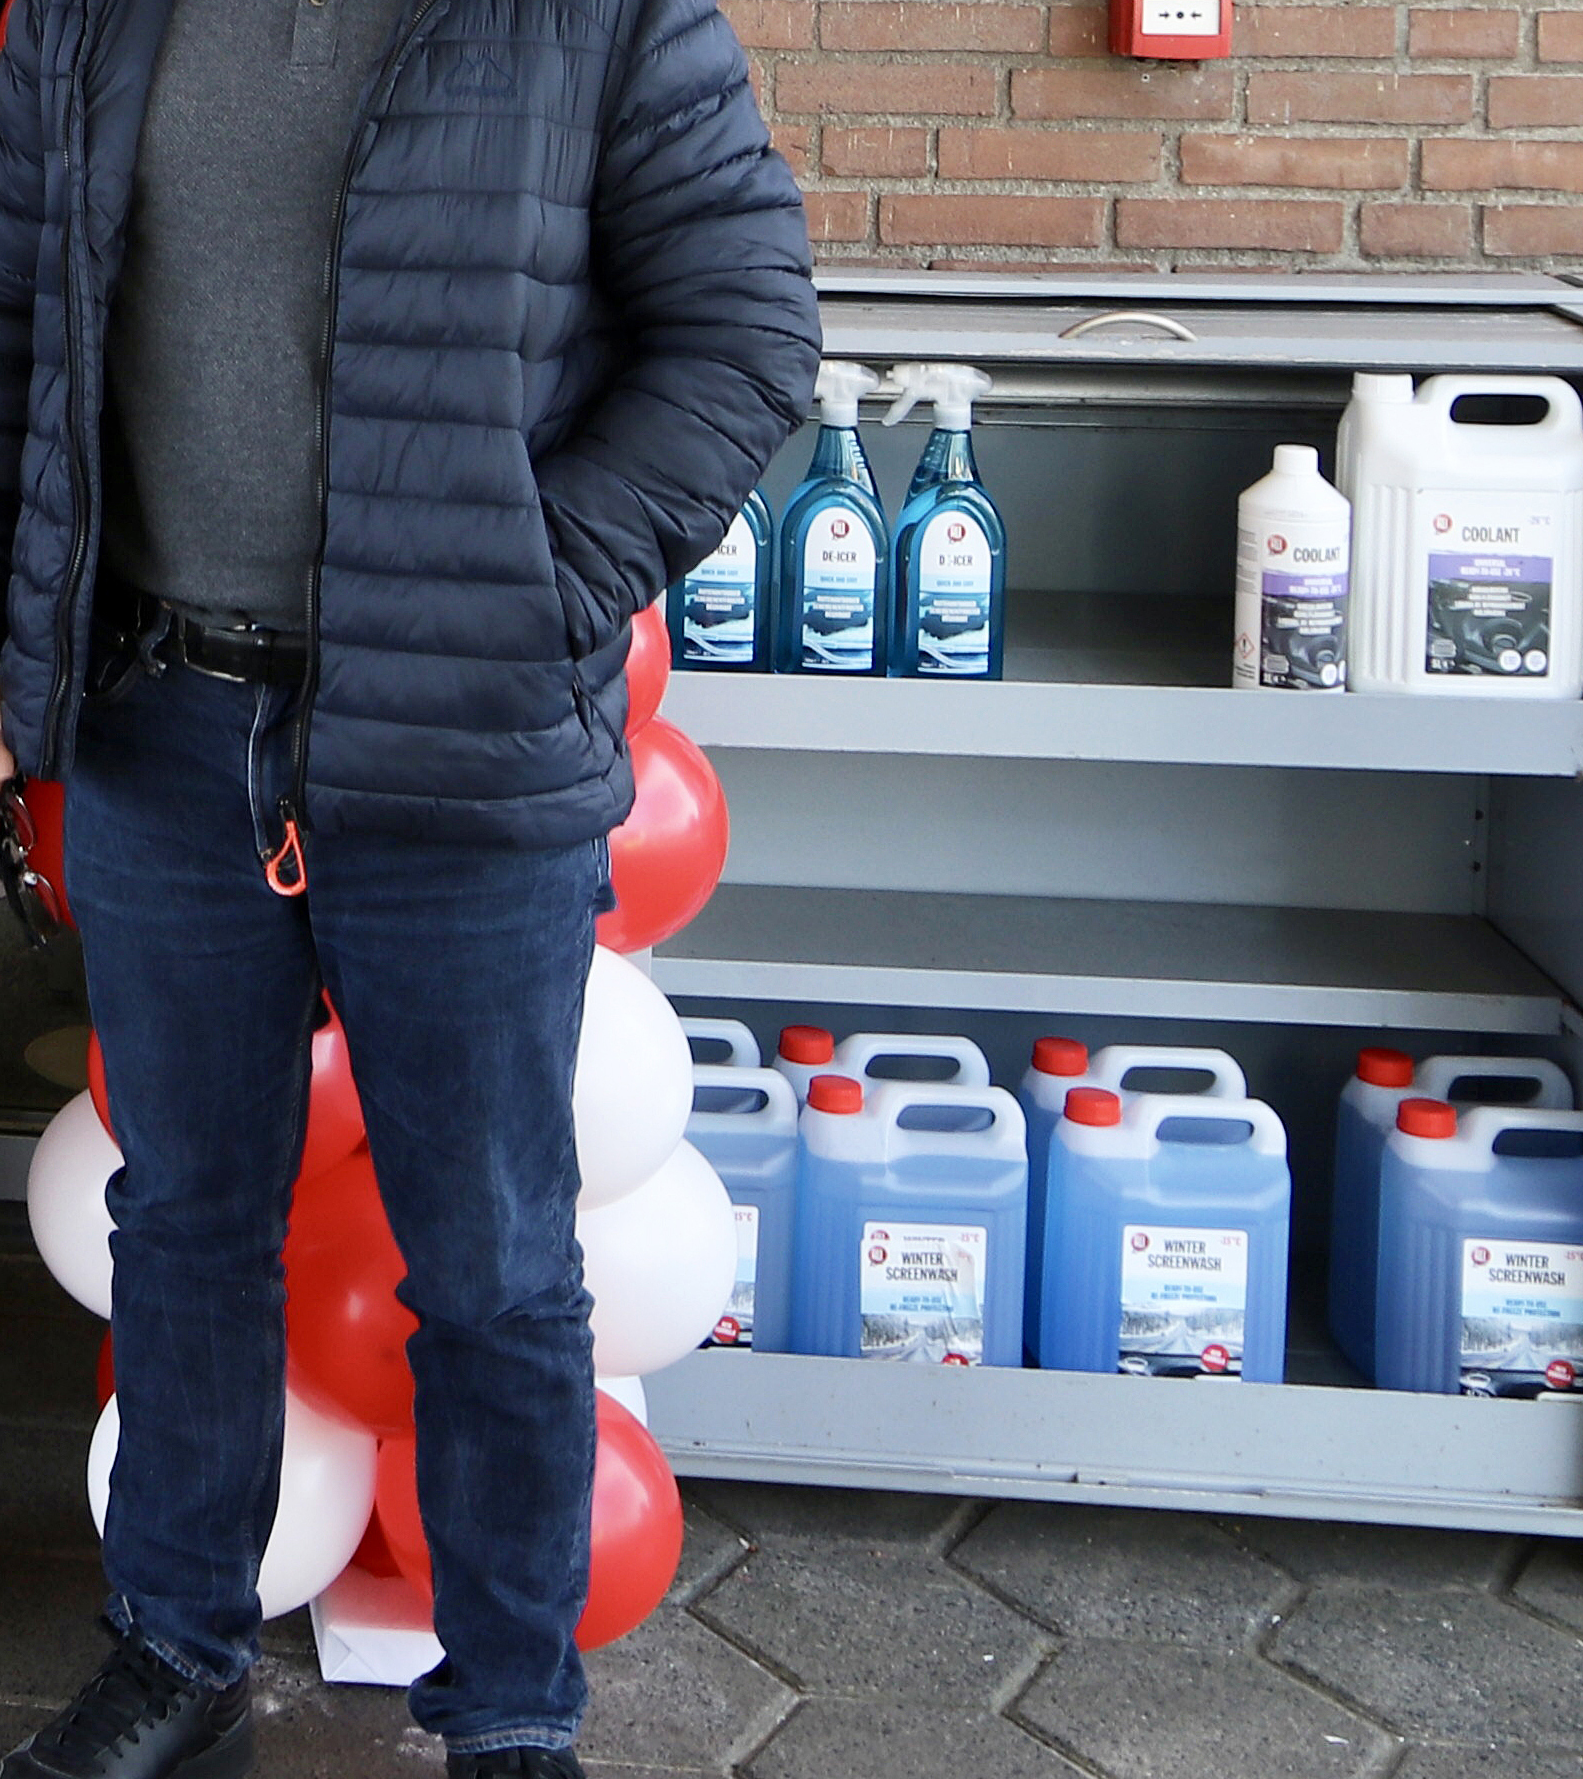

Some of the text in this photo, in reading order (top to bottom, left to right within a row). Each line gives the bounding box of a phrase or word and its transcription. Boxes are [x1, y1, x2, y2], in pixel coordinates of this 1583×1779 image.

[1462, 526, 1521, 543] COOLANT
[716, 545, 738, 556] ICER
[822, 550, 857, 563] DE-ICER
[1293, 547, 1341, 563] COOLANT
[735, 1211, 753, 1222] 15°C
[1164, 1239, 1206, 1254] WINTER
[901, 1251, 944, 1266] WINTER
[1147, 1254, 1222, 1271] SCREENWASH
[1506, 1252, 1549, 1268] WINTER
[885, 1266, 958, 1282] SCREENWASH
[1488, 1267, 1566, 1286] SCREENWASH
